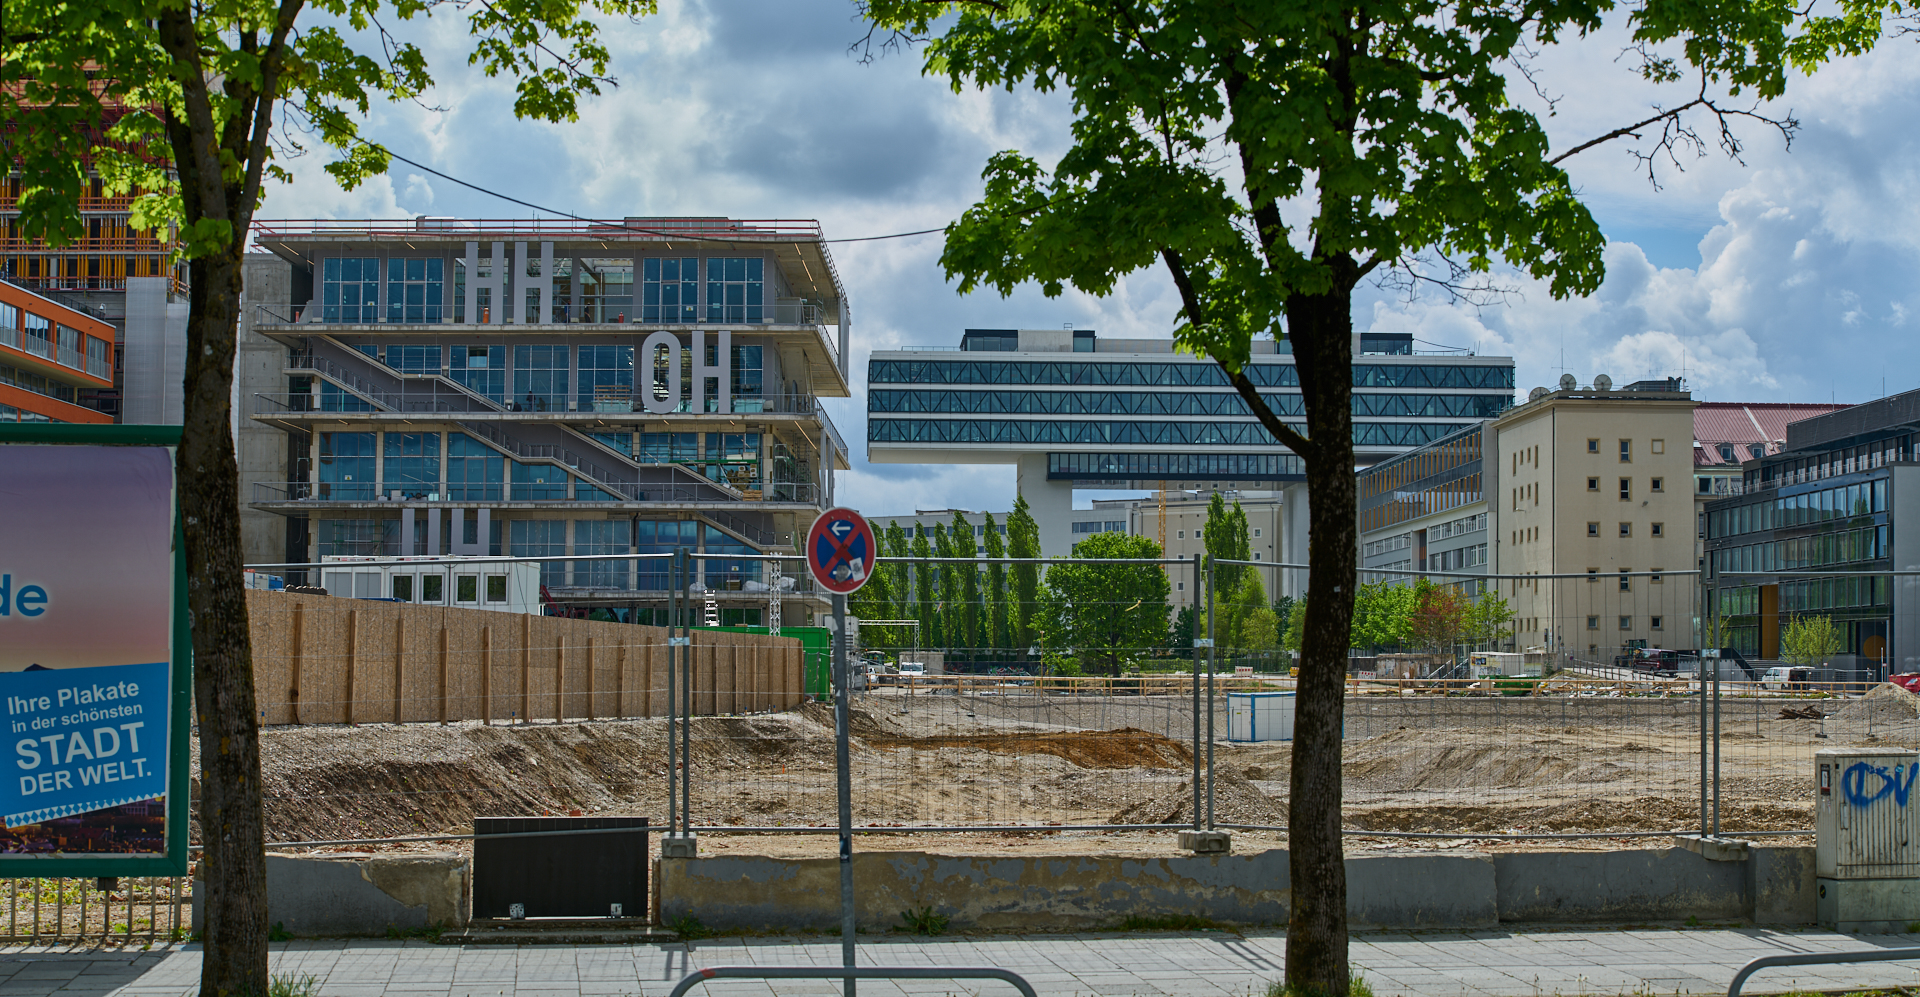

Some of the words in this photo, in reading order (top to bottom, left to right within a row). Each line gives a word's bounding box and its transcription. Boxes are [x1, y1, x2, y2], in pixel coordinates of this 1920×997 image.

[465, 241, 554, 324] HH
[641, 330, 731, 414] OH
[7, 695, 51, 715] Ihre
[57, 681, 140, 708] Plakate
[12, 720, 27, 733] in
[31, 716, 57, 730] der
[61, 704, 143, 726] schönsten
[15, 721, 145, 770] STADT
[20, 770, 73, 796] DER
[78, 757, 152, 786] WELT.
